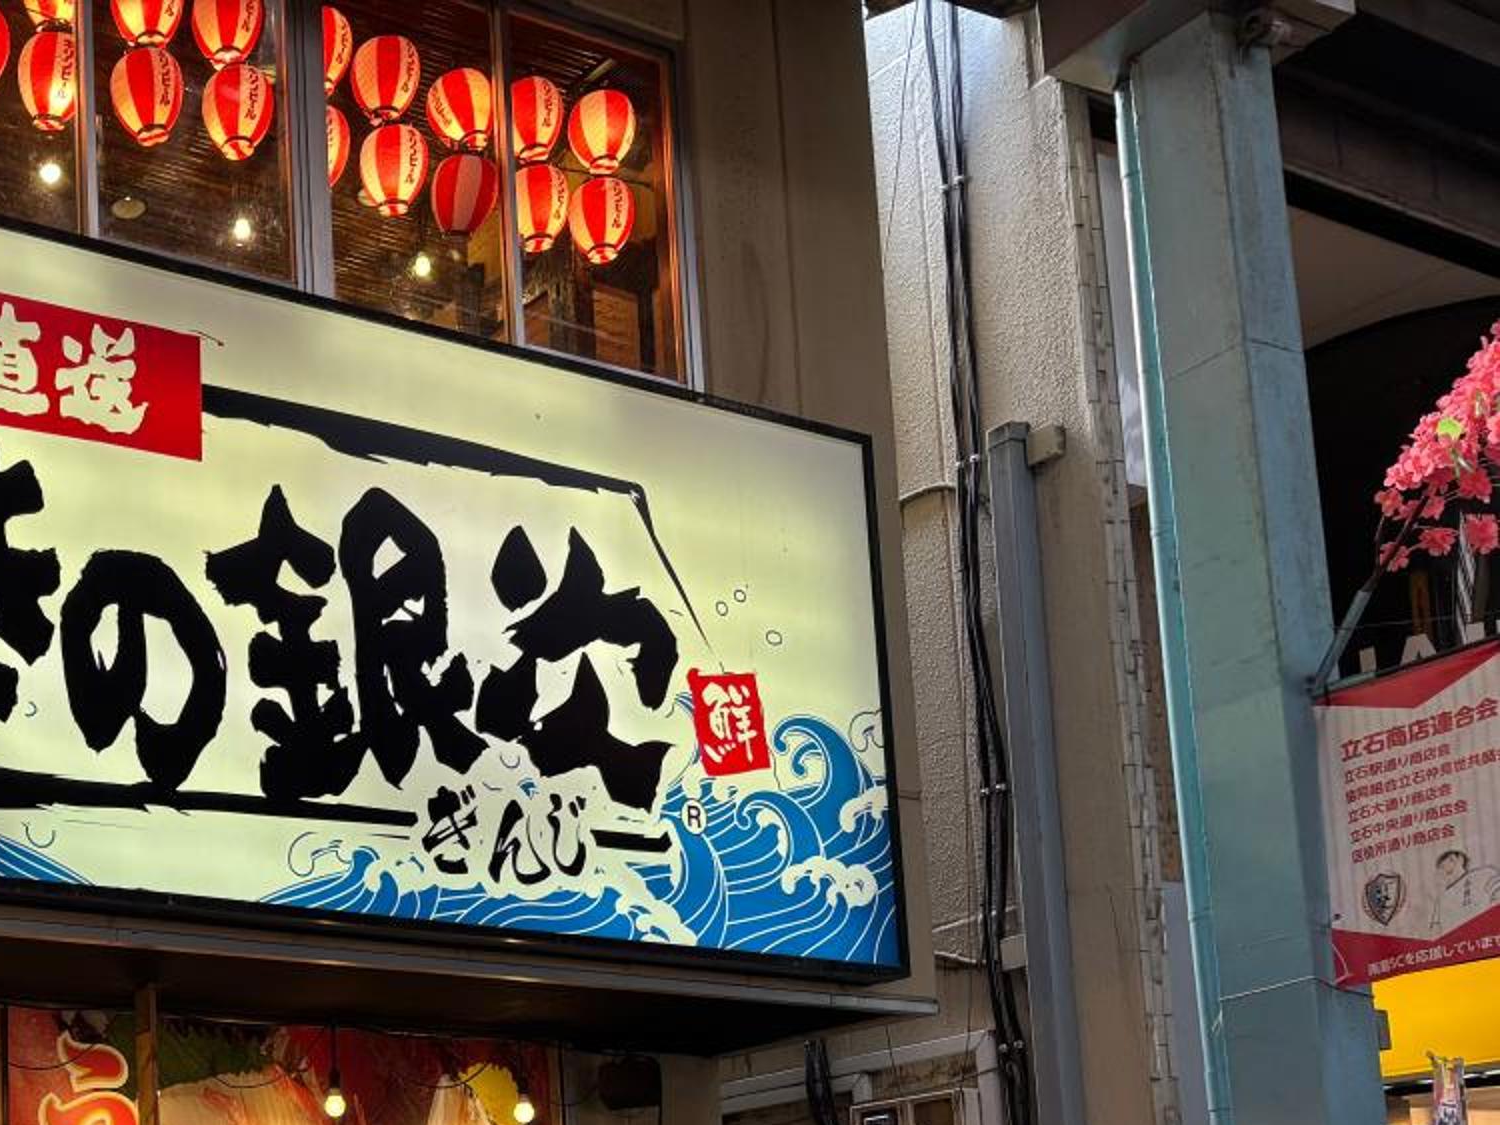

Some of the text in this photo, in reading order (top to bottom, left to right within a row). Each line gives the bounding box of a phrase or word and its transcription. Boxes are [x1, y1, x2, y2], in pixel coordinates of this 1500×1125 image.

[701, 681, 758, 763] 鮮
[1340, 697, 1499, 762] 立石商店連合会
[422, 784, 589, 884] ぎんじ
